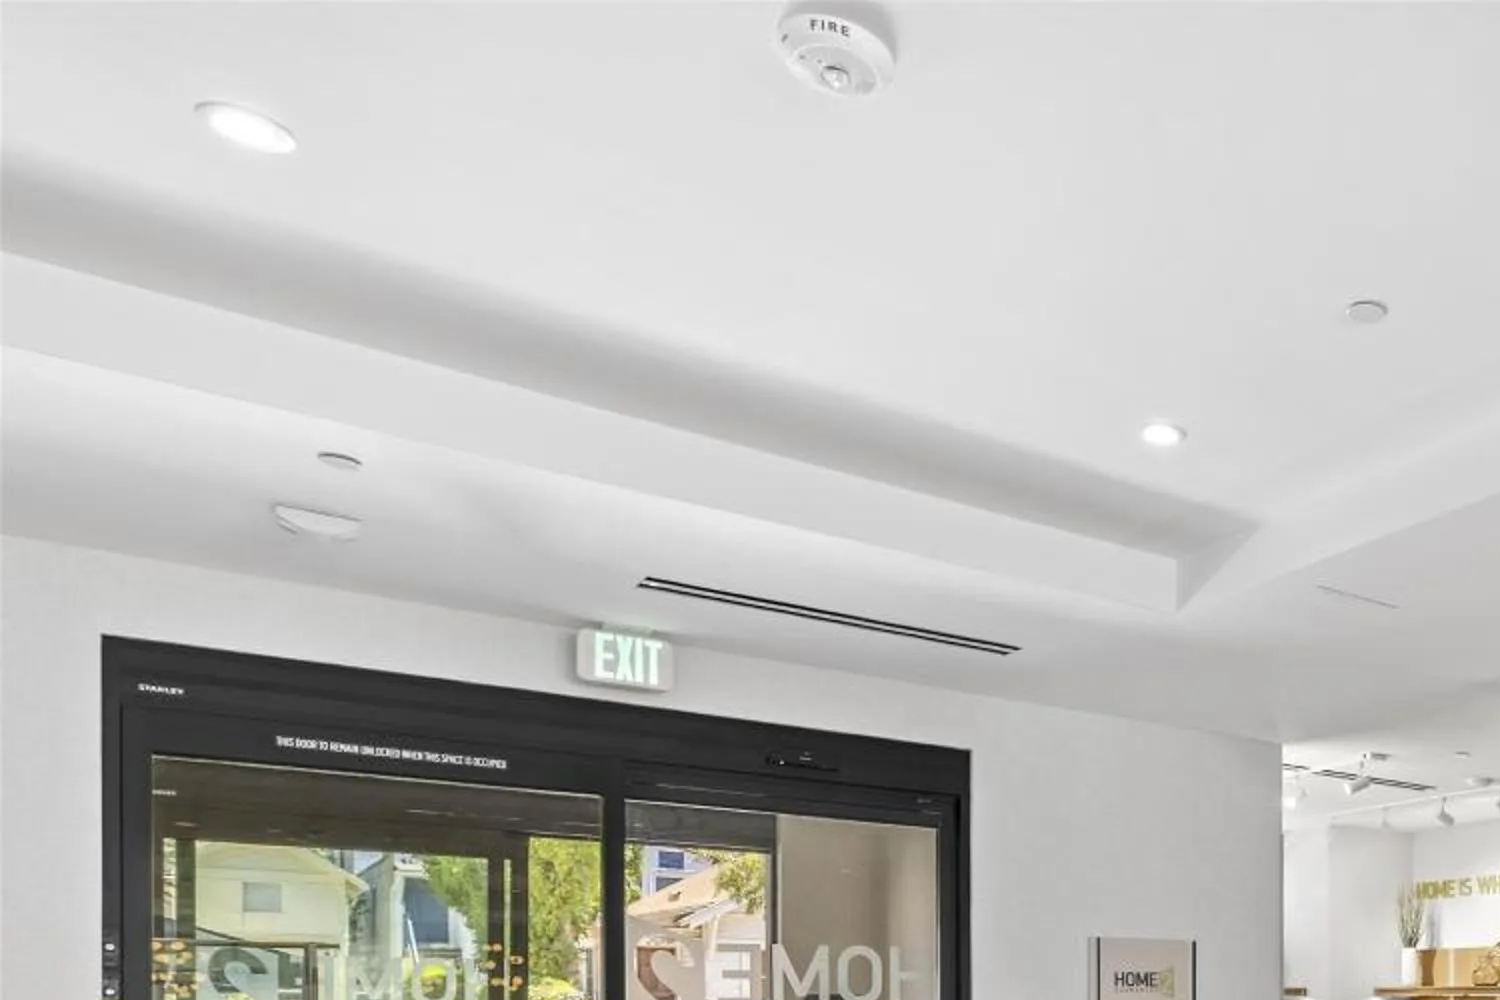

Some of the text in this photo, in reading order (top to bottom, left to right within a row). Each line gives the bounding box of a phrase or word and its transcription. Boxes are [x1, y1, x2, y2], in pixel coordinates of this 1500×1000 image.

[809, 19, 850, 37] FIRE
[595, 631, 663, 685] EXIT
[1416, 879, 1456, 900] HOME
[1459, 877, 1473, 896] IS
[1114, 971, 1159, 987] HOME
